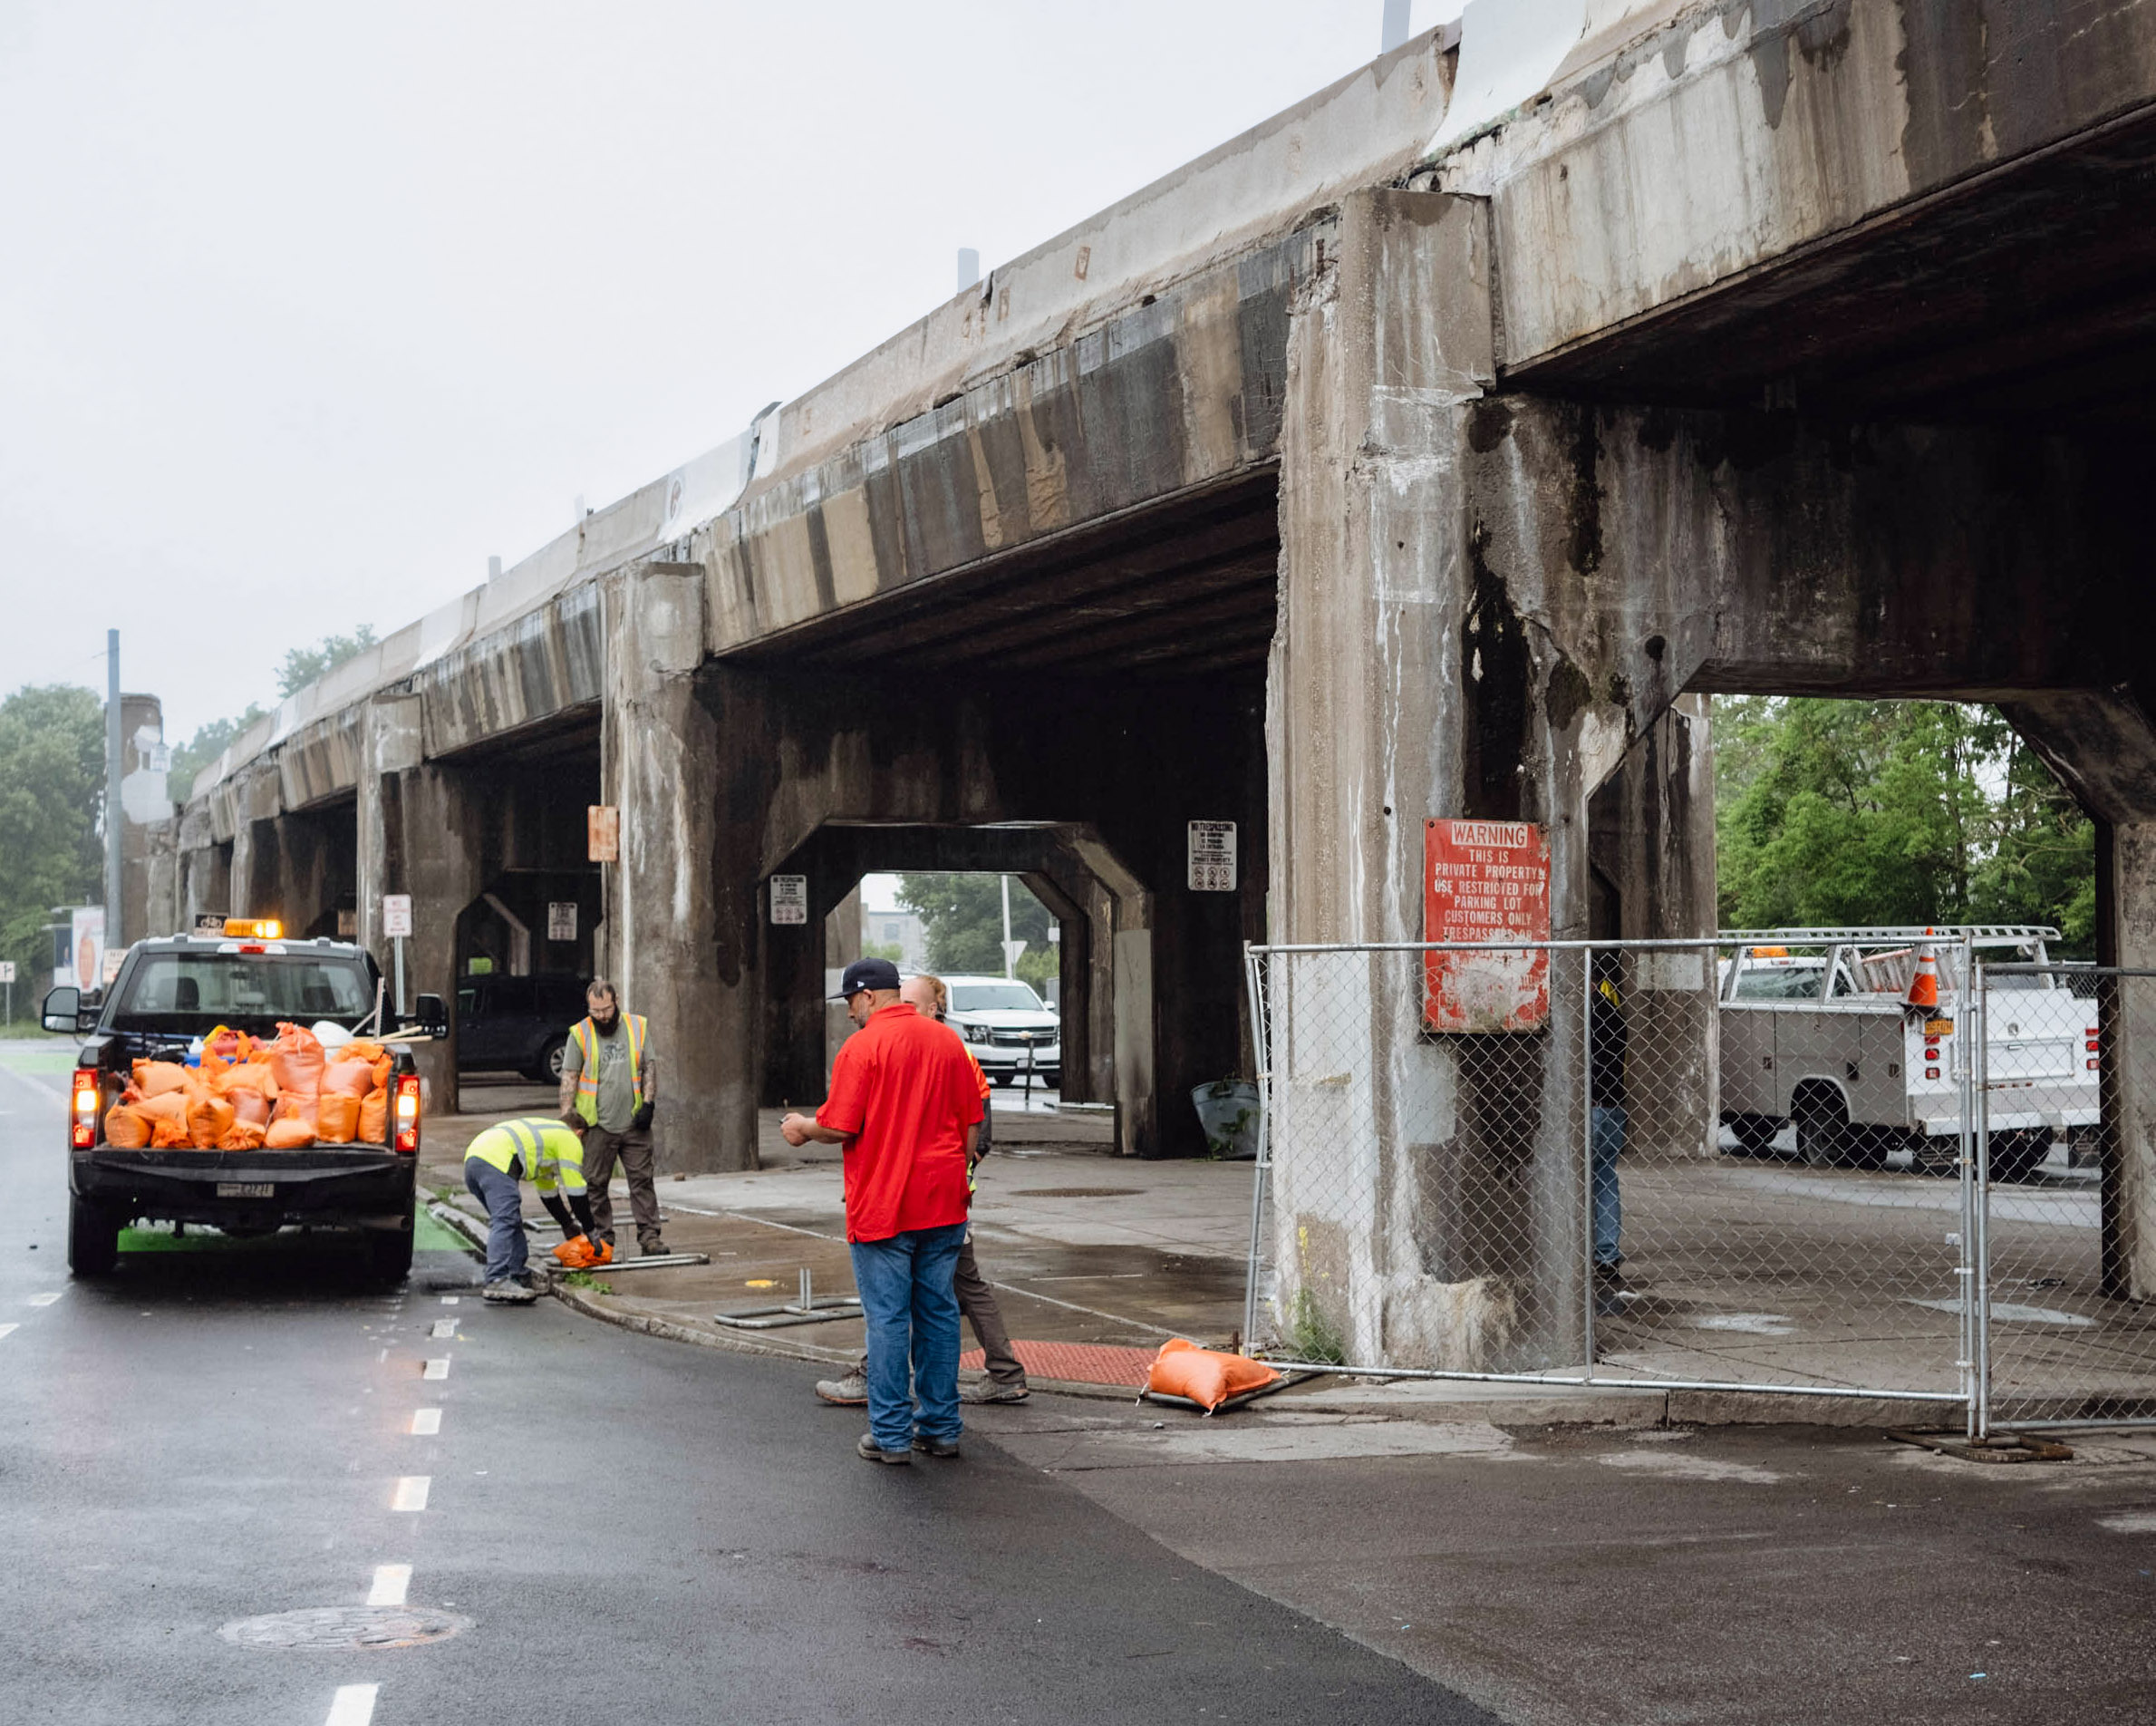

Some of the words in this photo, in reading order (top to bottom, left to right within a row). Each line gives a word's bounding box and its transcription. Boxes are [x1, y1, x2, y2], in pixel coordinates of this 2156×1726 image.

[1454, 824, 1525, 846] WARNING
[1468, 848, 1494, 863] THIS
[1498, 850, 1510, 863] IS
[1435, 863, 1478, 878] PRIVATE
[1434, 878, 1454, 894] USE
[1459, 880, 1519, 896] RESTRICTED
[1523, 883, 1542, 897] FOR
[1454, 895, 1496, 909] PARKING
[1504, 897, 1523, 910] LOT
[1445, 909, 1503, 926] CUSTOMERS
[1508, 912, 1532, 926] ONLY
